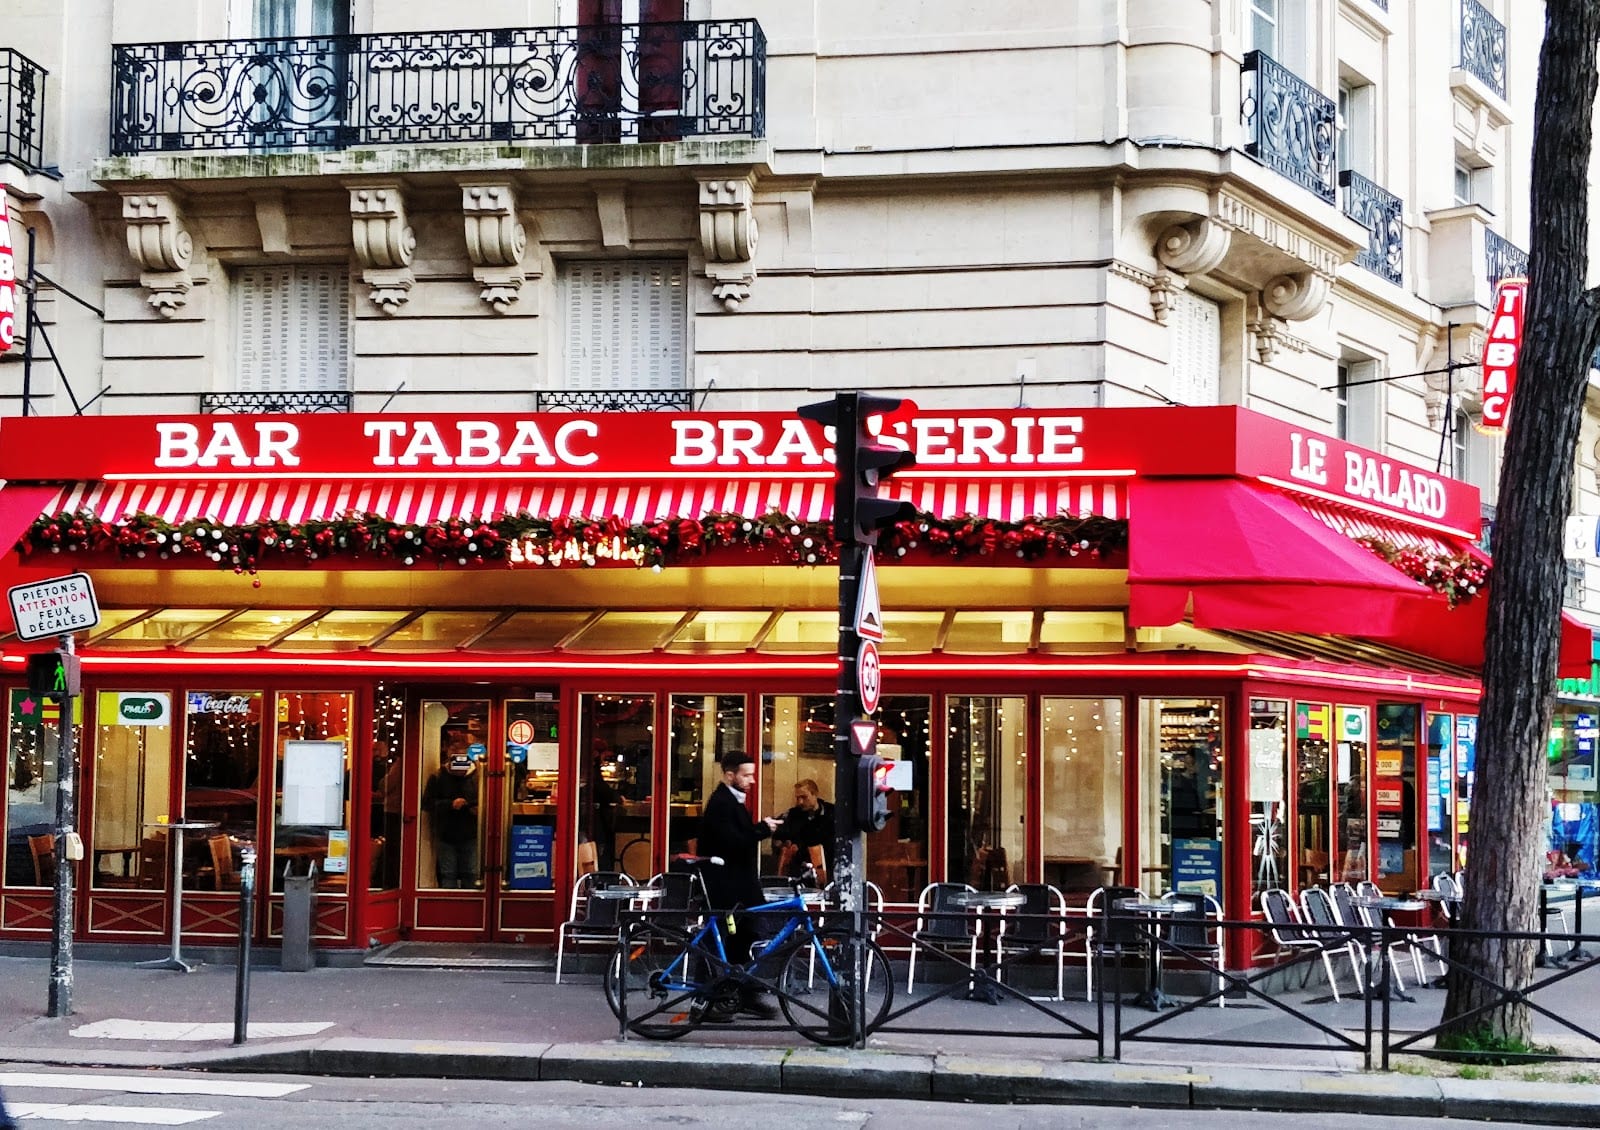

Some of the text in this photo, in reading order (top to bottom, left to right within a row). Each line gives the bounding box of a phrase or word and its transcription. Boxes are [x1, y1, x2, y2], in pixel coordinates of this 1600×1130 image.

[1483, 289, 1519, 420] TABAC
[154, 421, 301, 468] BAR
[363, 419, 599, 467] TABAC
[1290, 432, 1447, 519] LE BALARD
[19, 591, 88, 613] ATTENTION
[22, 582, 78, 601] PIÉTONS
[29, 614, 87, 633] DÉCALÉS
[39, 606, 72, 620] FEUX
